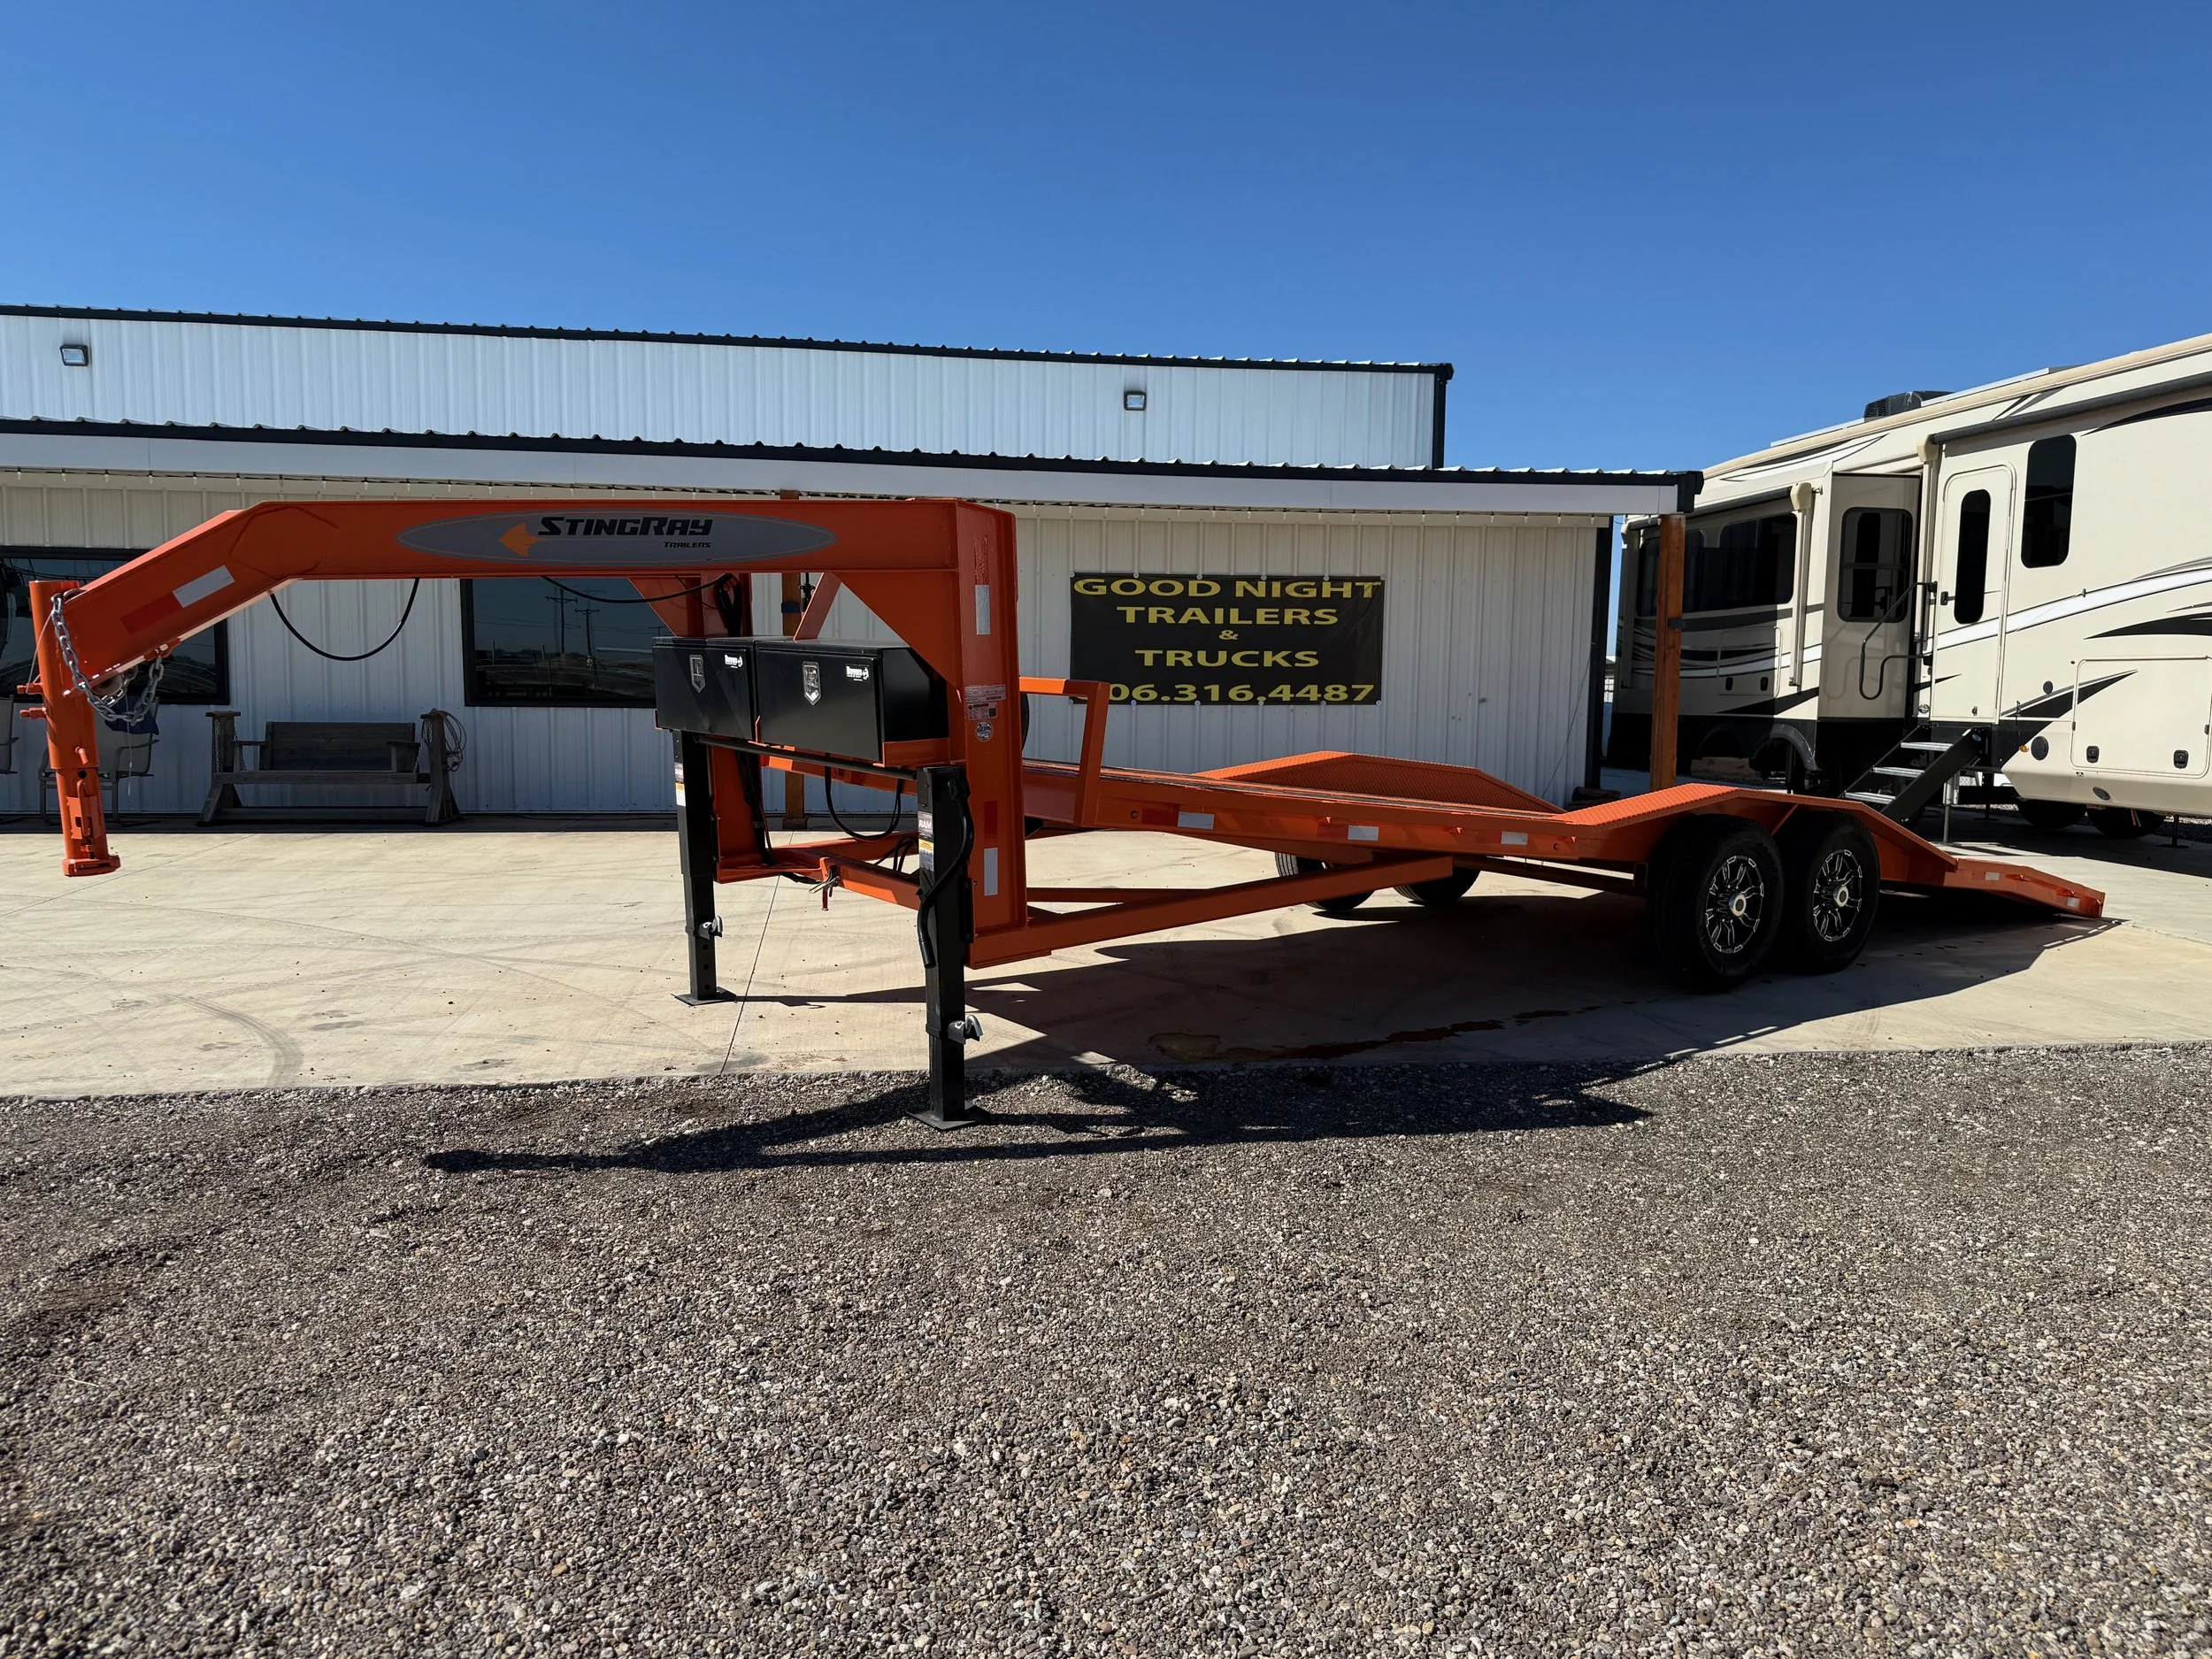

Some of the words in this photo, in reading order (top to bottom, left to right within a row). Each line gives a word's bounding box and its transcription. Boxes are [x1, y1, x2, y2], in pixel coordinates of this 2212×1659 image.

[1073, 579, 1221, 597] GOOD
[1235, 580, 1381, 598] NIGHT
[1117, 607, 1339, 625] TRAILERS
[1218, 630, 1238, 640] &
[1135, 650, 1319, 667] TRUCKS
[1071, 684, 1374, 702] 06.316.4487
